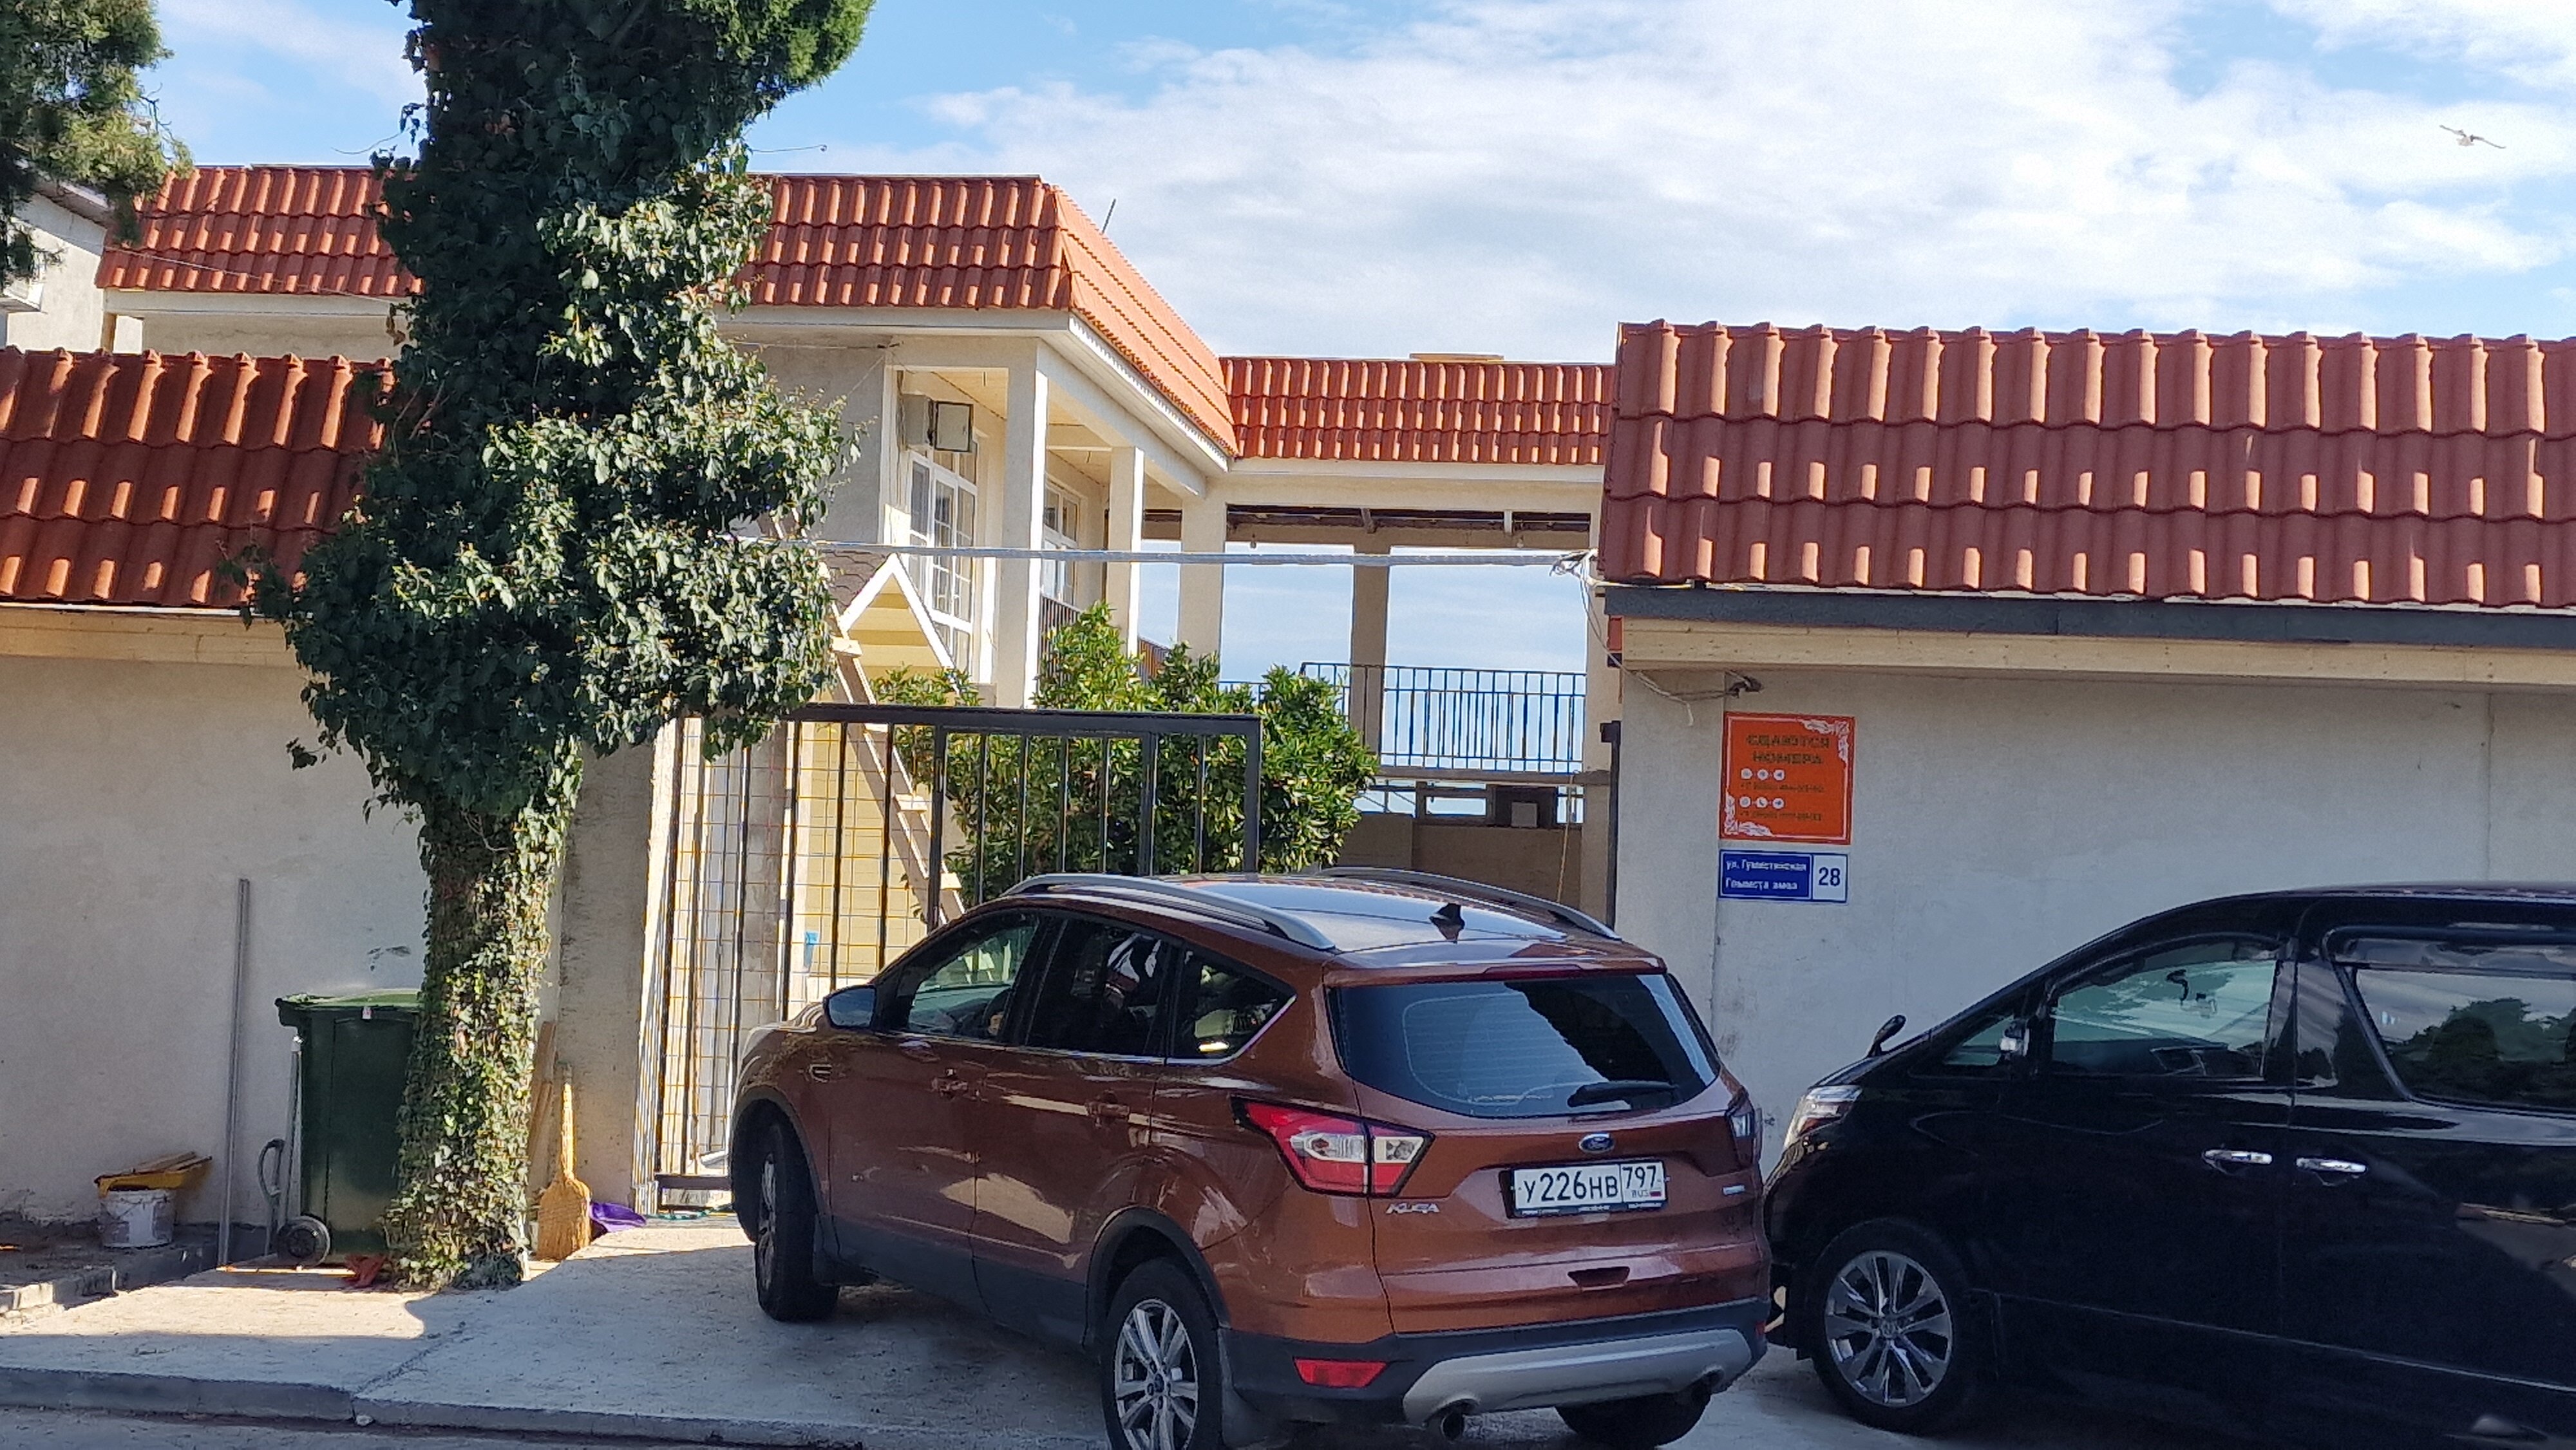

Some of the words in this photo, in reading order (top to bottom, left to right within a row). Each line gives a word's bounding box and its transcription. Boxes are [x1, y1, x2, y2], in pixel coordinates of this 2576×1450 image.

[1747, 735, 1830, 748] СДАЮТСЯ
[1726, 860, 1739, 870] ул.
[1818, 867, 1841, 887] 28
[1622, 1165, 1656, 1189] 797
[1385, 1202, 1440, 1214] KUGA
